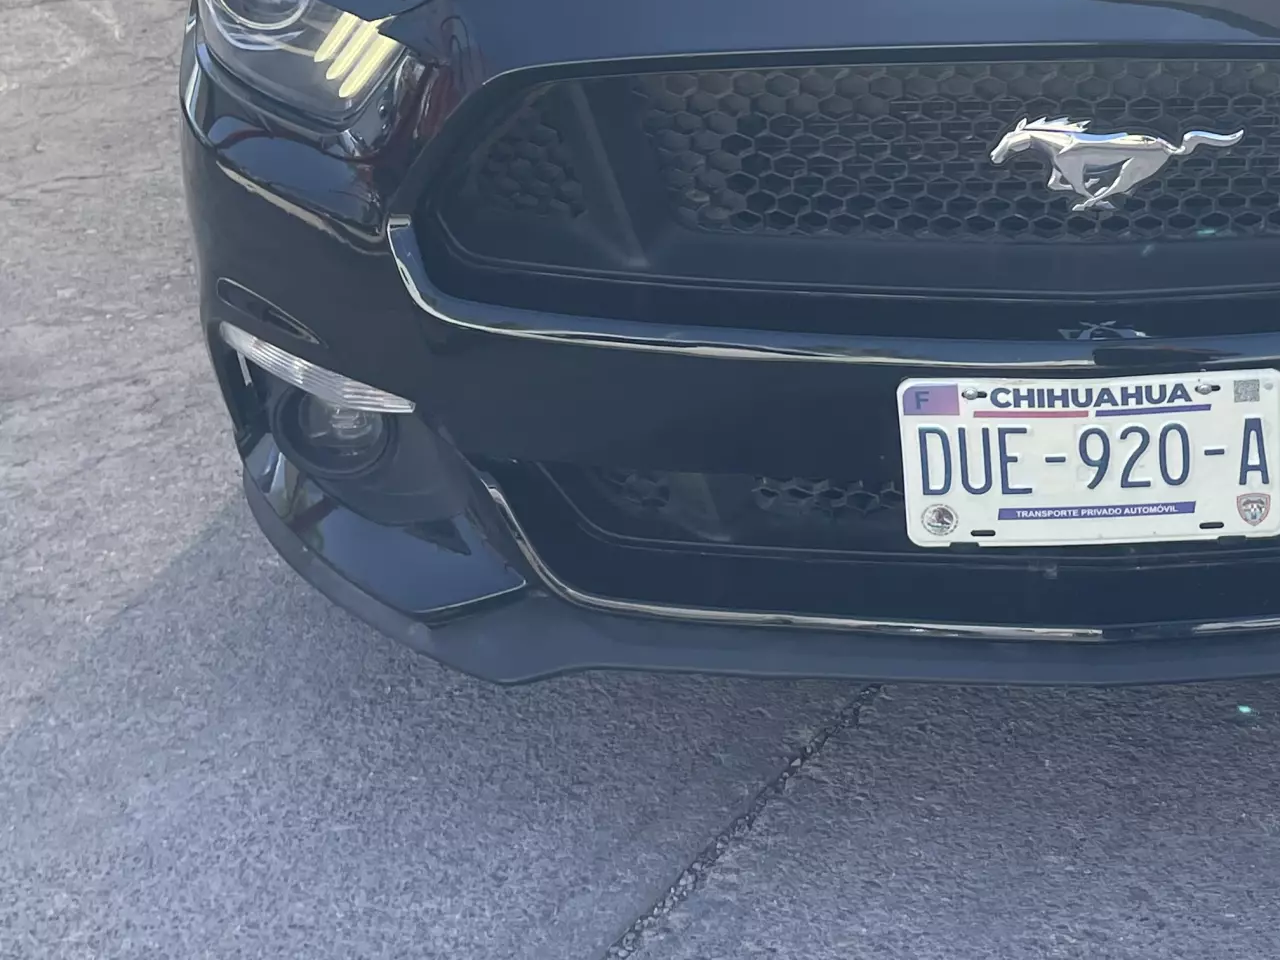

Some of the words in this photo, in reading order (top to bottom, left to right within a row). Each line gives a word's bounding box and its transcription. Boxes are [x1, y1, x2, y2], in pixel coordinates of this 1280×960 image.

[915, 390, 930, 409] F
[989, 383, 1193, 409] CHIHUAHUA
[917, 417, 1270, 496] DUE-920-A
[1015, 508, 1079, 519] TRANSPORTE
[1080, 507, 1122, 517] PRIVADO
[1123, 504, 1179, 515] AUTOMÓVIL
